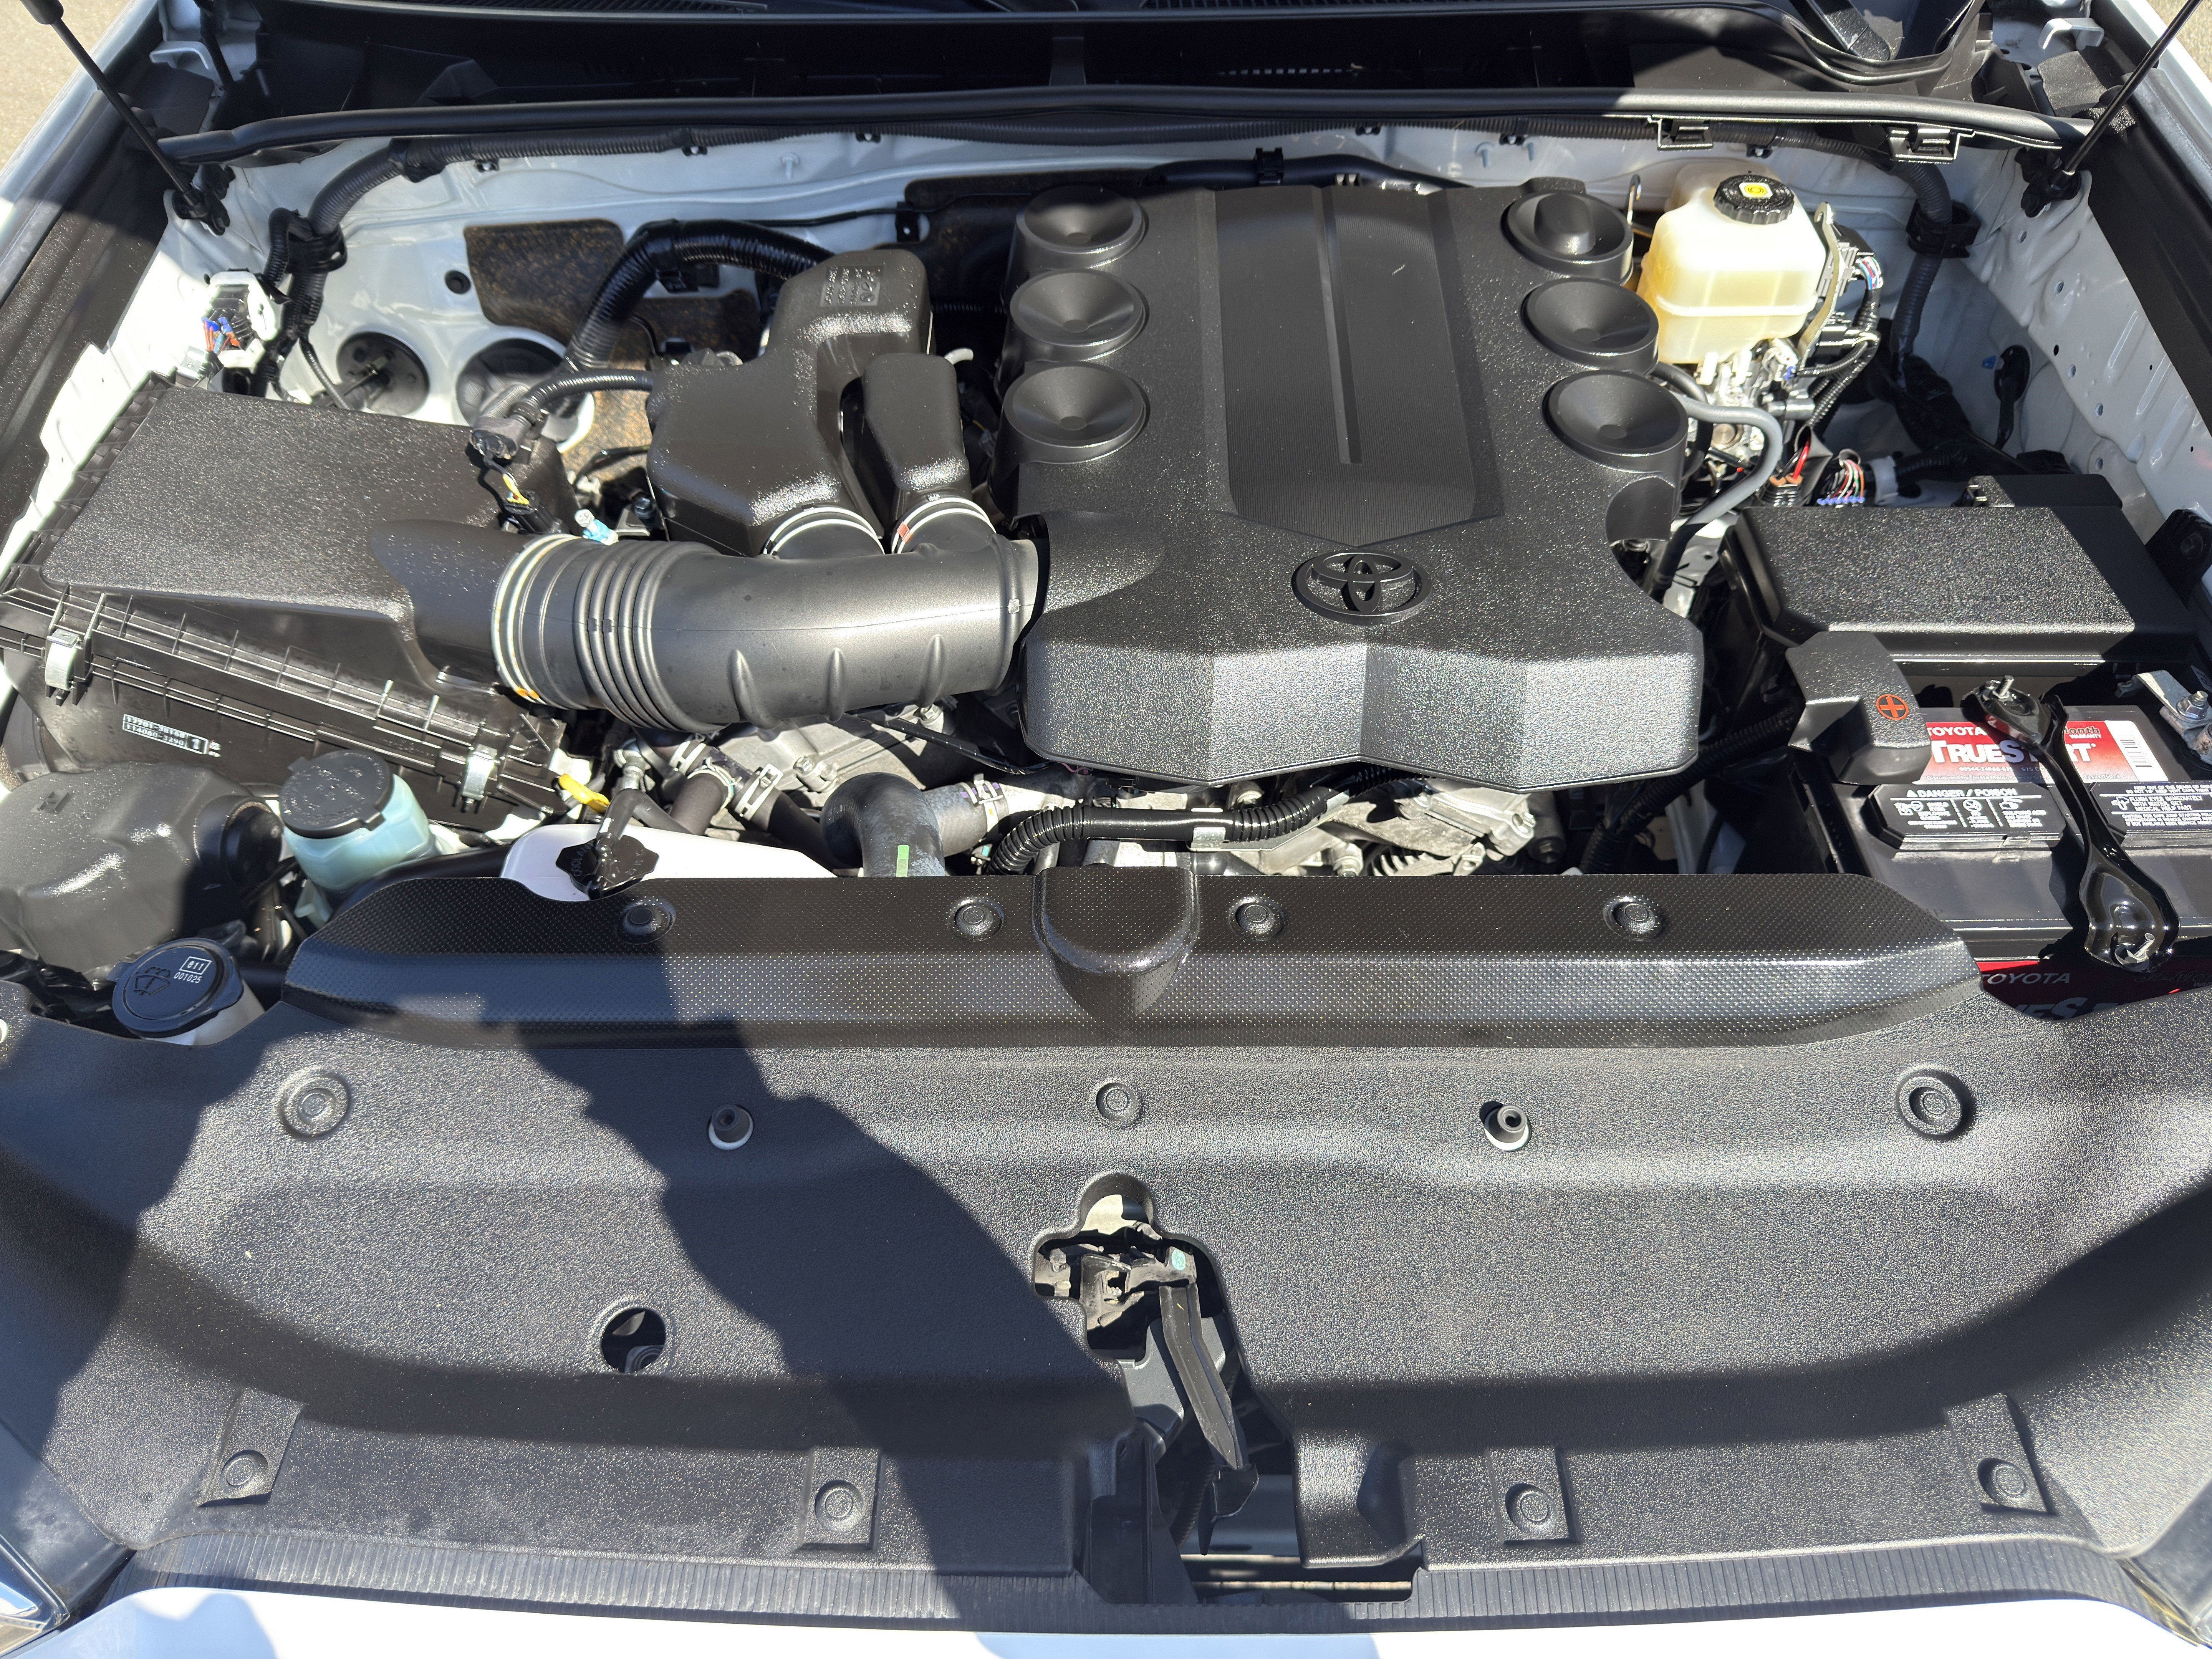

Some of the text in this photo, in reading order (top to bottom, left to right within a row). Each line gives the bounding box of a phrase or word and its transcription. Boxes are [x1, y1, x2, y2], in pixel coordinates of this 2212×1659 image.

[126, 724, 184, 746] 114060-3290
[1927, 727, 1987, 736] TOYOTA
[2064, 726, 2100, 734] onth
[192, 738, 201, 750] 1
[1917, 789, 1964, 798] DANGER
[1975, 788, 2018, 796] POISON
[187, 961, 204, 970] e11
[174, 972, 203, 983] 001025
